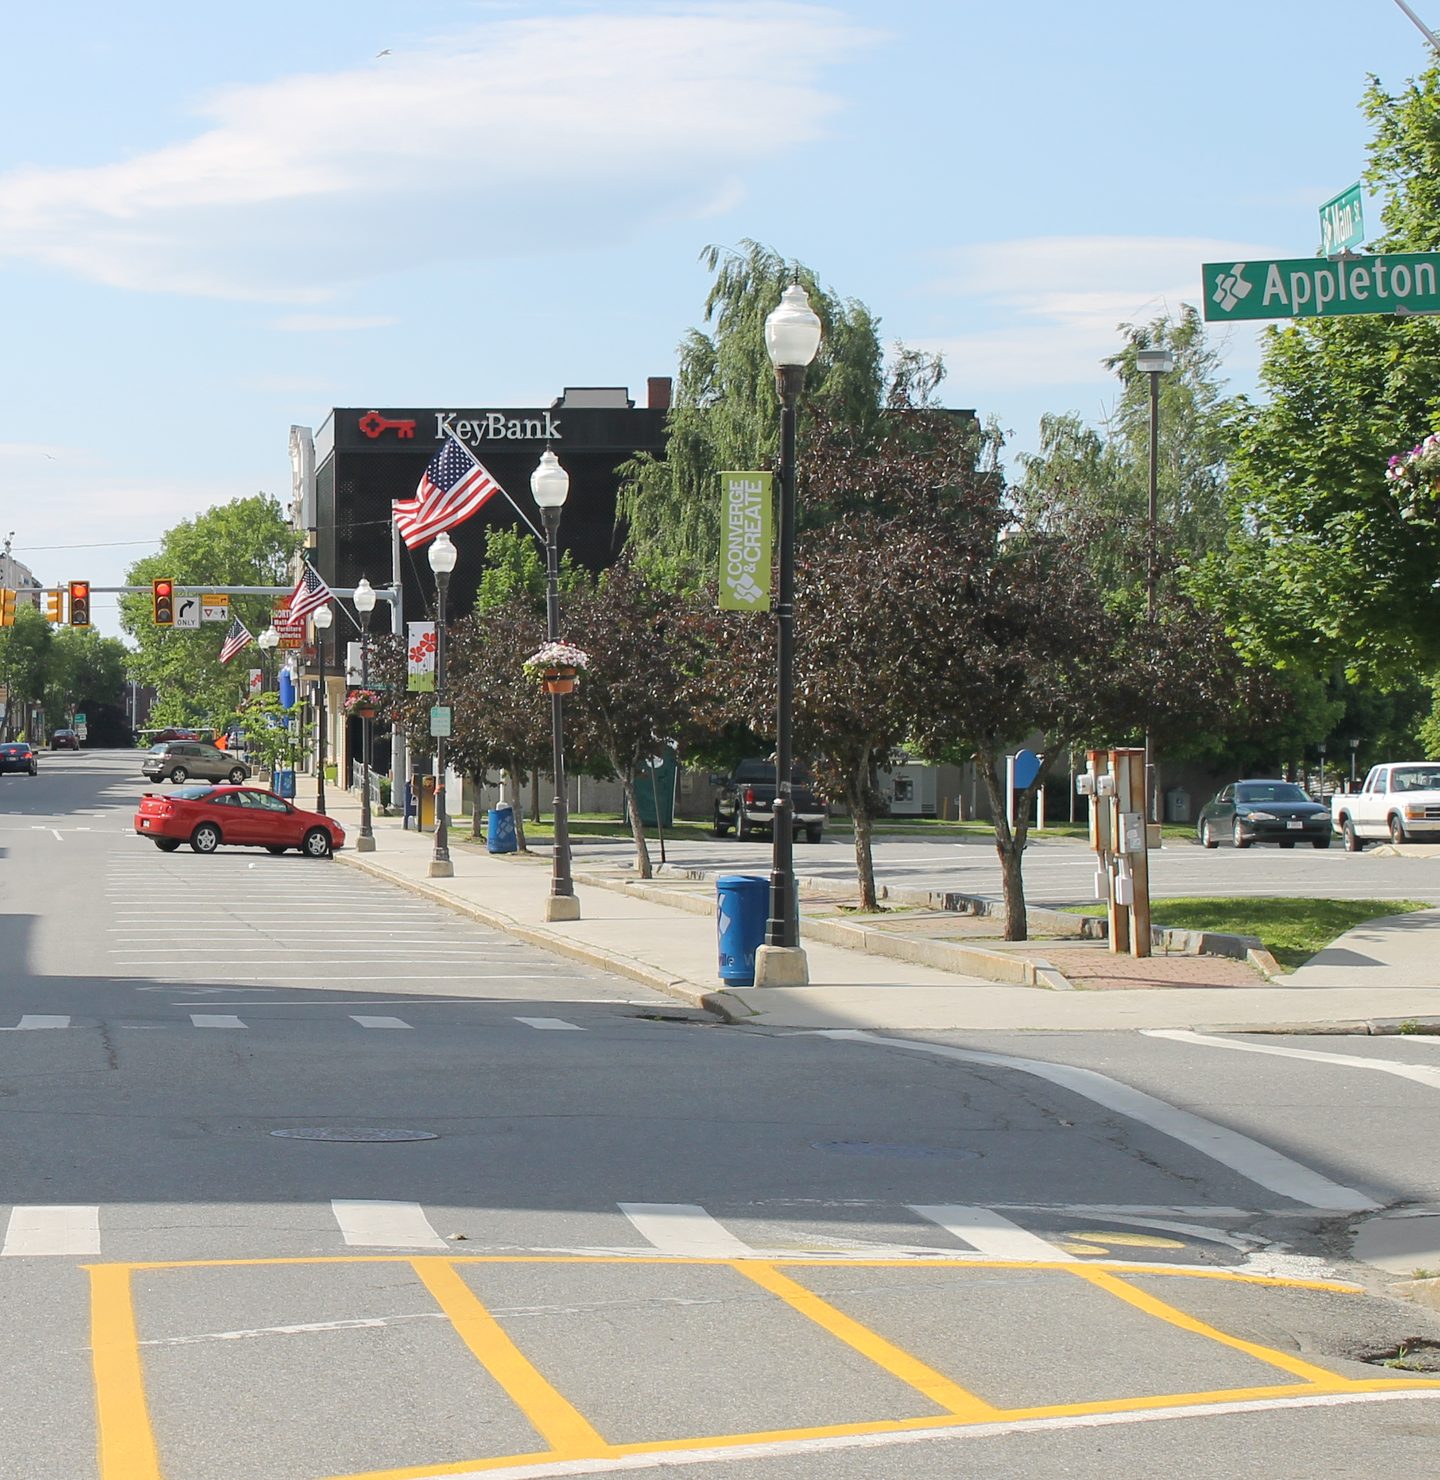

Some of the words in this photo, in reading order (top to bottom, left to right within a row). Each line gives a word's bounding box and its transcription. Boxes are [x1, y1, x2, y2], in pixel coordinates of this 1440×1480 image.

[1331, 199, 1353, 247] Main
[1262, 257, 1437, 315] Appleton
[434, 411, 563, 447] KeyBank
[727, 479, 745, 576] CONVERGE
